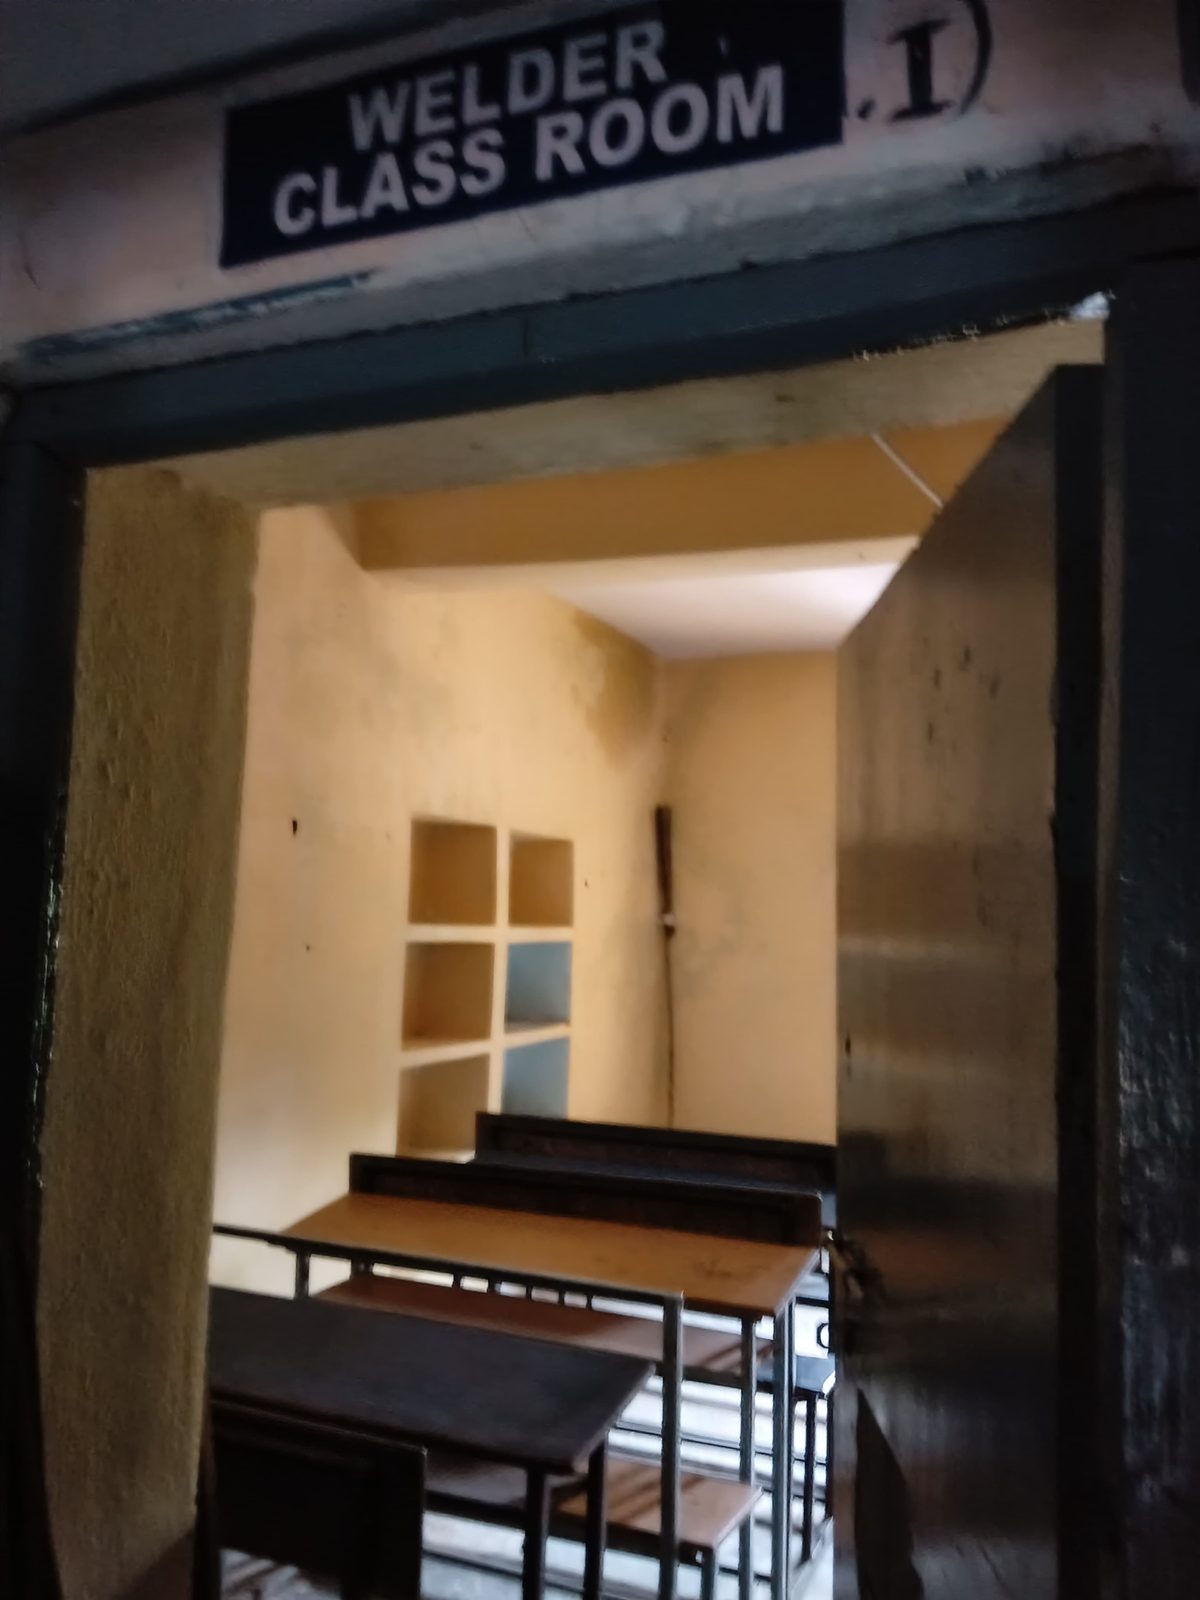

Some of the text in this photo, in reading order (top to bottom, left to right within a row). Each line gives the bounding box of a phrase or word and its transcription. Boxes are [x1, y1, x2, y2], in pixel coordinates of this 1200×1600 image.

[274, 66, 786, 236] CLASS ROOM
[349, 20, 668, 152] WELDER
